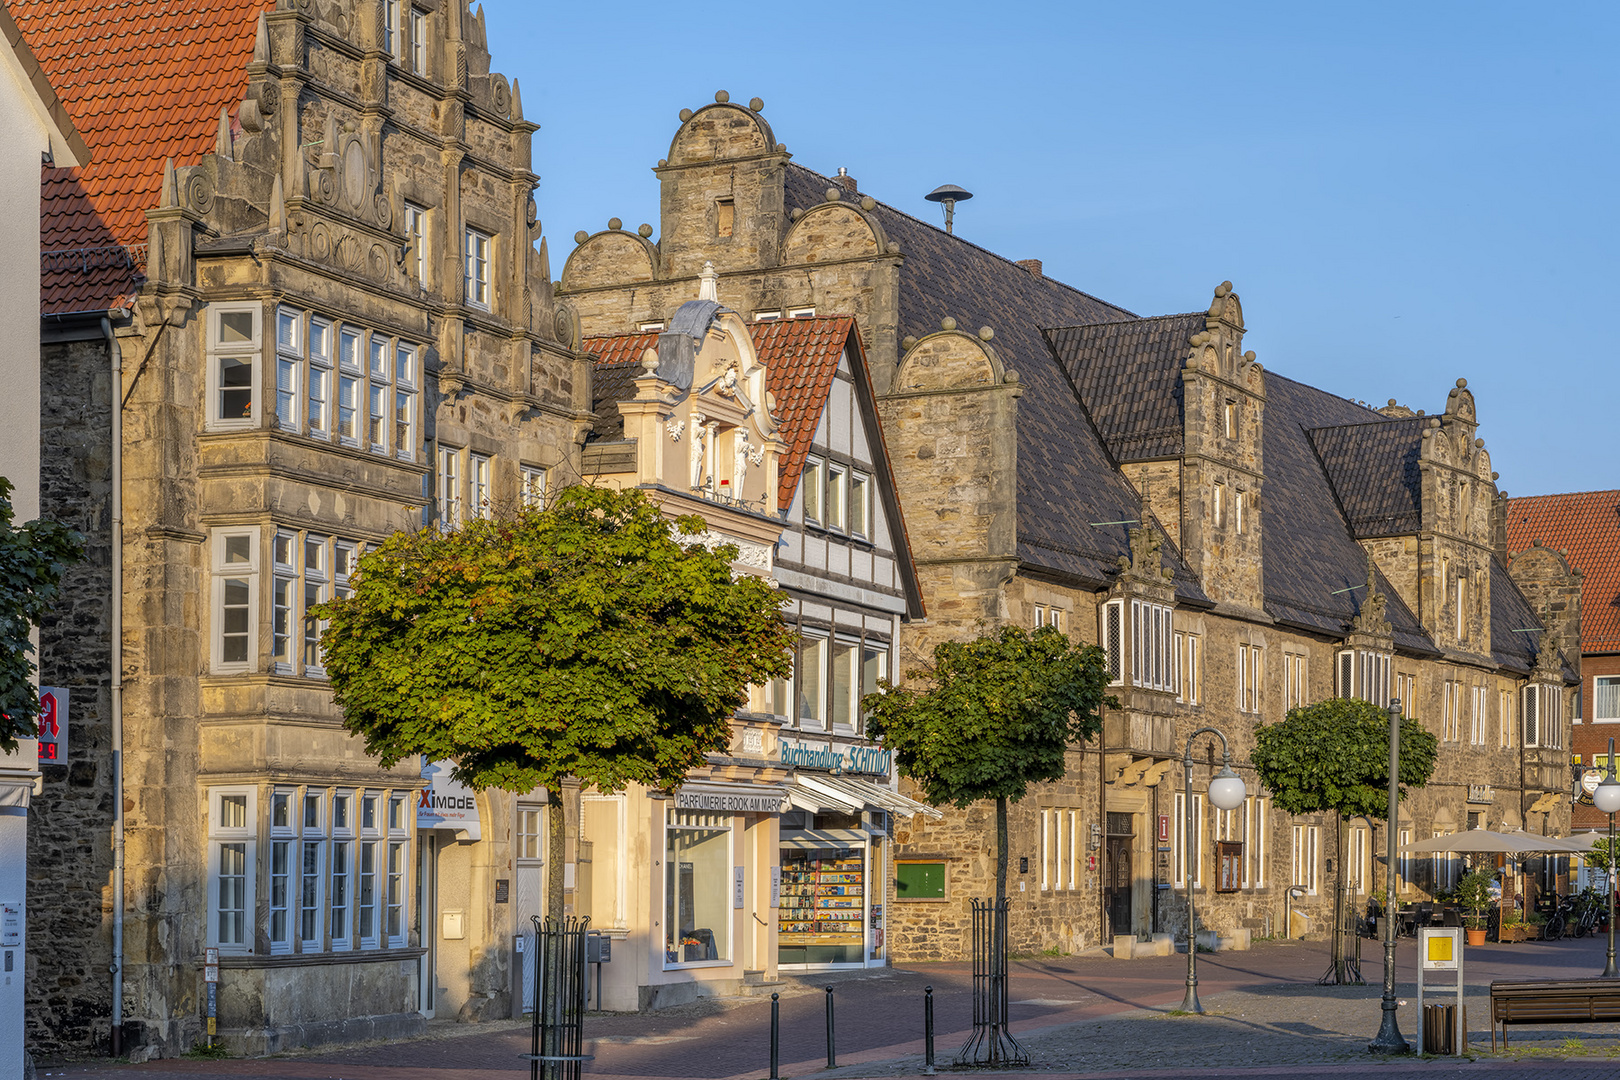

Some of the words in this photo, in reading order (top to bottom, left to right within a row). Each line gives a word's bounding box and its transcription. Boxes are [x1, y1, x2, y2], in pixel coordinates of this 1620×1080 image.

[780, 741, 844, 774] Buchhandlung
[679, 793, 727, 810] PARFÜMERIE
[727, 796, 749, 811] ROOK
[750, 798, 760, 811] AM
[761, 798, 781, 811] MARK
[1162, 819, 1167, 836] i
